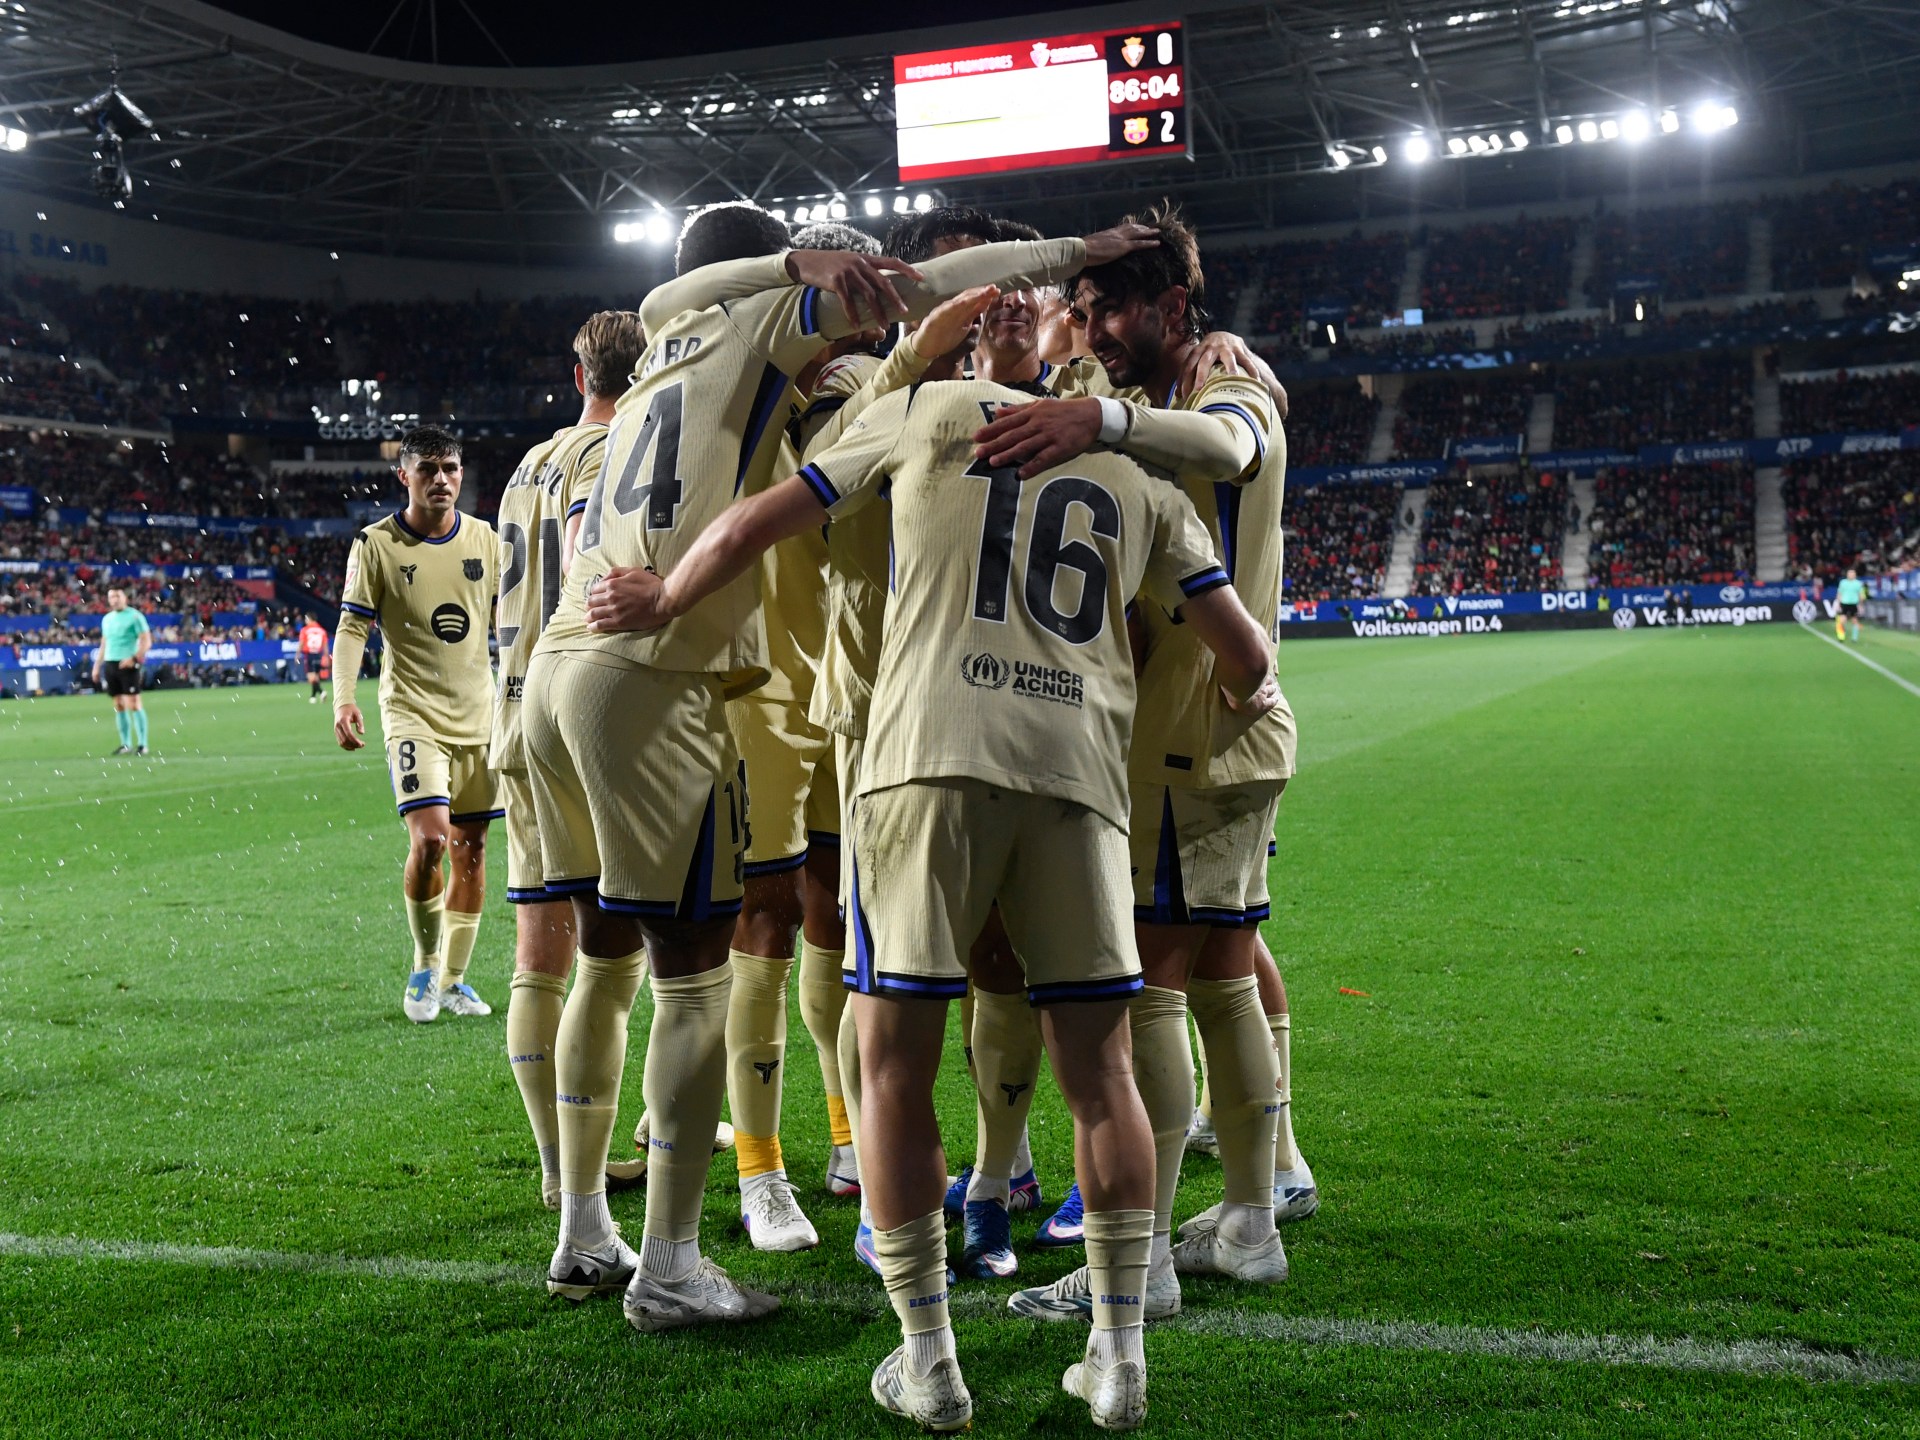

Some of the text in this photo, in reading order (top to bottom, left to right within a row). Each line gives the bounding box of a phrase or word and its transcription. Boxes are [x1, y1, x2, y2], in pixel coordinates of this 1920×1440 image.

[1109, 73, 1180, 104] 86:04
[1160, 111, 1176, 143] 2
[1694, 446, 1744, 460] EROSKI
[1776, 437, 1812, 457] ATP
[581, 380, 684, 553] 14
[961, 454, 1121, 646] 16
[499, 517, 562, 648] 21
[1459, 597, 1504, 611] macron
[1541, 591, 1587, 611] DIGI
[1352, 614, 1503, 638] Volkswagen ID.4
[1014, 660, 1084, 688] UNHCR
[1012, 676, 1083, 703] ACNUR
[1036, 693, 1061, 703] Refugee
[1062, 698, 1083, 710] Agency
[398, 740, 416, 772] 8
[1100, 1294, 1139, 1306] BARÇA
